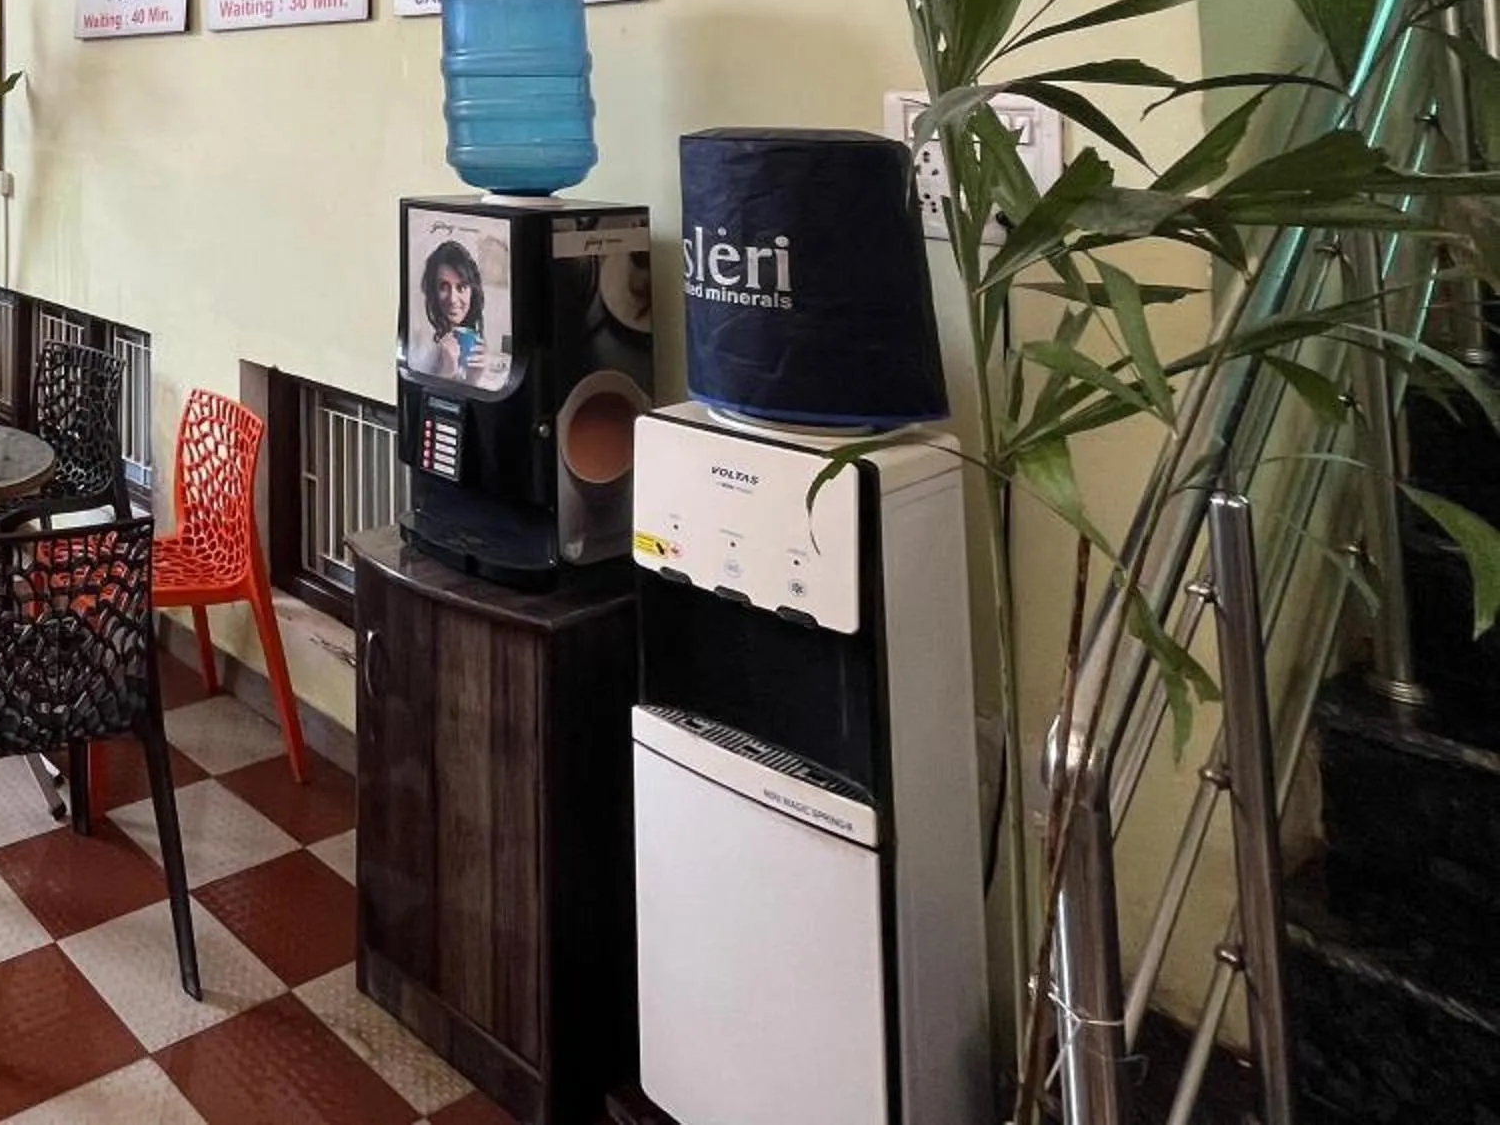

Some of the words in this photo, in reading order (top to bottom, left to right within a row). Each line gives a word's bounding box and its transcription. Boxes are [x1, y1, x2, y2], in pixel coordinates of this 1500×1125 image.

[83, 12, 122, 30] Waiting
[131, 8, 145, 24] 40
[705, 287, 793, 309] minerals
[711, 466, 759, 486] VOLTAS
